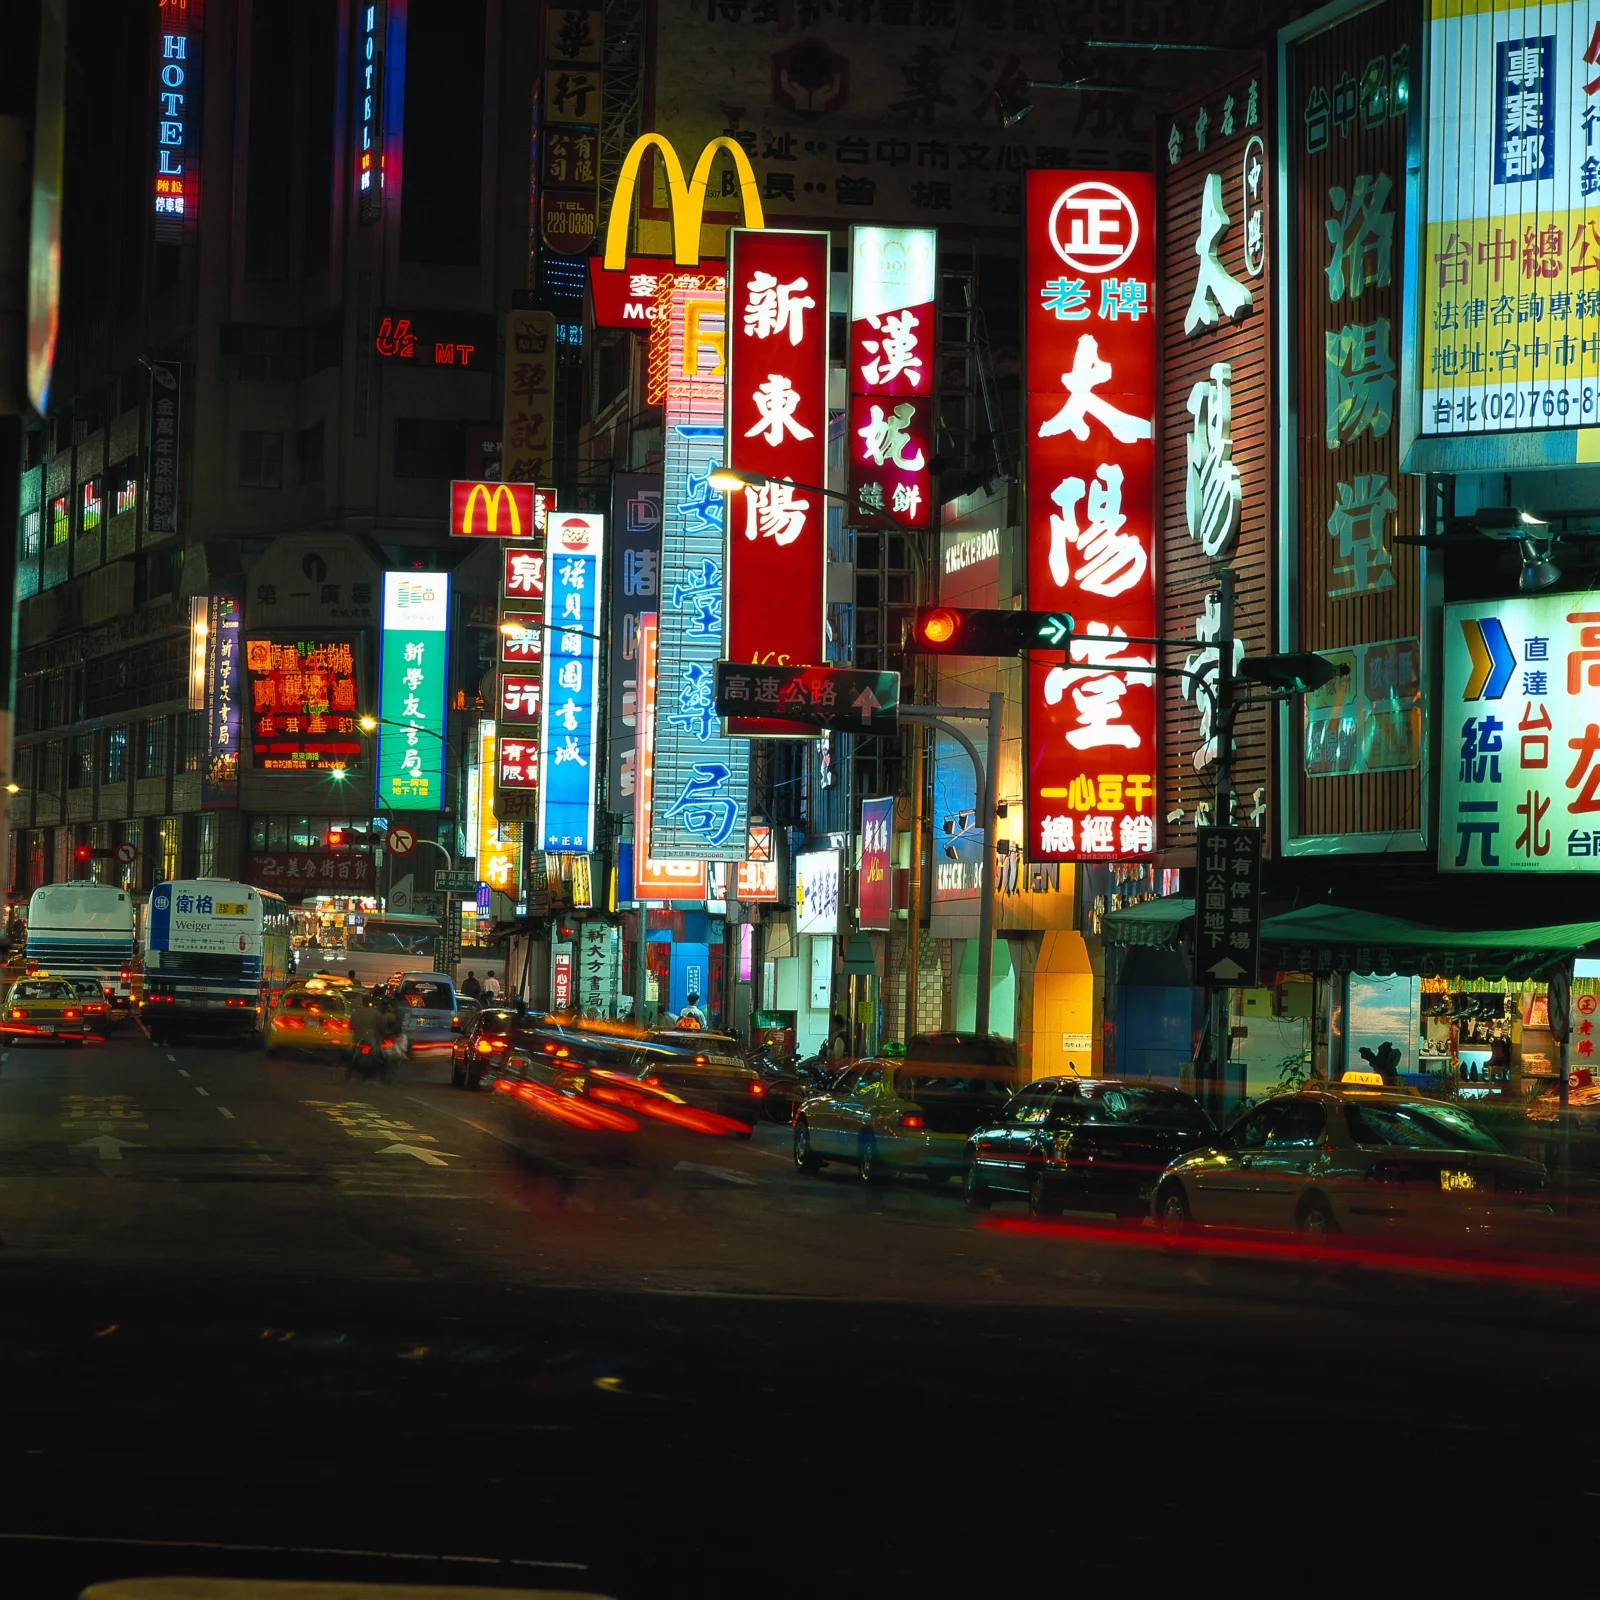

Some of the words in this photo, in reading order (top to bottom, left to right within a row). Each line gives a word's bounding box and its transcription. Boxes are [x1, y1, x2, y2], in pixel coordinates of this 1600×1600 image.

[361, 5, 376, 151] HOTEL
[160, 34, 187, 176] HOTEL
[1503, 46, 1545, 178] 專案部
[155, 197, 185, 214] 停車場
[156, 179, 184, 194] 附設
[556, 201, 585, 211] TEL
[547, 211, 595, 236] 223-0336
[1064, 198, 1124, 256] 正
[1040, 276, 1149, 322] 老牌
[742, 269, 819, 547] 新東陽
[1431, 386, 1600, 425] 台北(02)766-8
[151, 397, 176, 532] 金萬年保齡球館
[945, 527, 1000, 575] KNICKERBOX
[1037, 333, 1154, 751] 太陽堂
[256, 583, 373, 606] 第一廣場
[552, 557, 589, 768] 諾貝爾圖書城
[1522, 635, 1550, 696] 直達
[401, 641, 427, 776] 新學友書局
[724, 674, 838, 708] 高速公路
[1040, 773, 1153, 813] 一心豆干
[1515, 701, 1553, 857] 台北
[548, 836, 584, 846] 中正店
[1040, 814, 1154, 854] 總經銷
[1567, 829, 1600, 857] 台
[176, 894, 213, 915] 衛格
[1203, 835, 1228, 949] 中山公園地下
[1229, 835, 1253, 950] 公有停車場
[175, 920, 212, 933] Weiger
[584, 929, 606, 1007] 新大方書局
